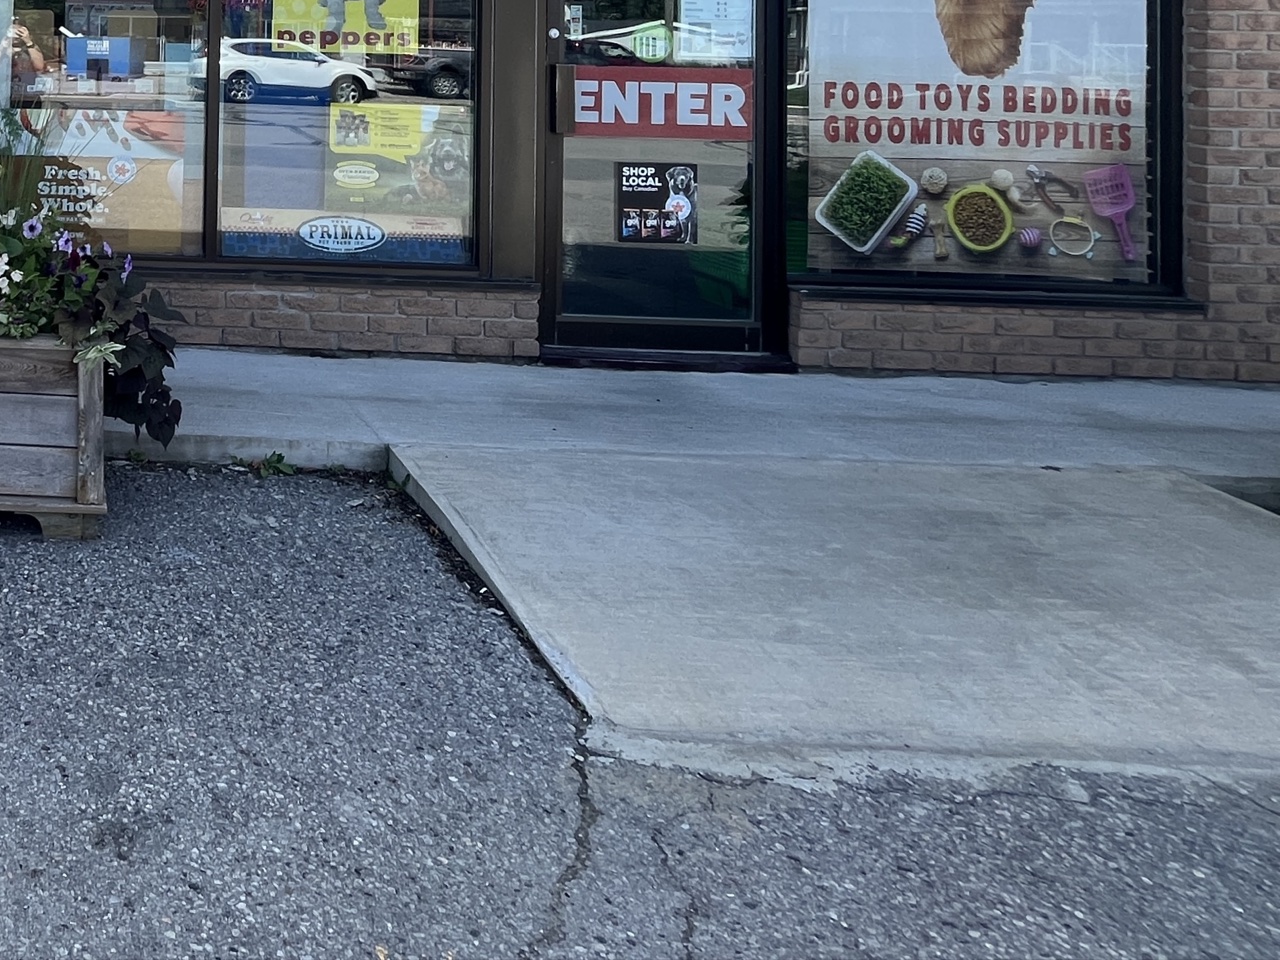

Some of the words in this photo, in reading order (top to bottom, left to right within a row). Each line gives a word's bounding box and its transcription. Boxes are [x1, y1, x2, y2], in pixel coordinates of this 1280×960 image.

[277, 29, 411, 49] peppers
[574, 80, 747, 127] ENTER
[823, 81, 903, 110] FOOD
[915, 83, 991, 112] TOYS
[1003, 85, 1132, 117] BEDDING
[823, 115, 985, 146] GROOMING
[997, 118, 1132, 151] SUPPLIES
[44, 165, 107, 181] Fresh.
[622, 167, 655, 176] SHOP
[622, 176, 662, 186] LOCAL
[37, 181, 113, 199] Simple.
[40, 198, 109, 213] Whole.
[308, 225, 376, 241] PRIMAL
